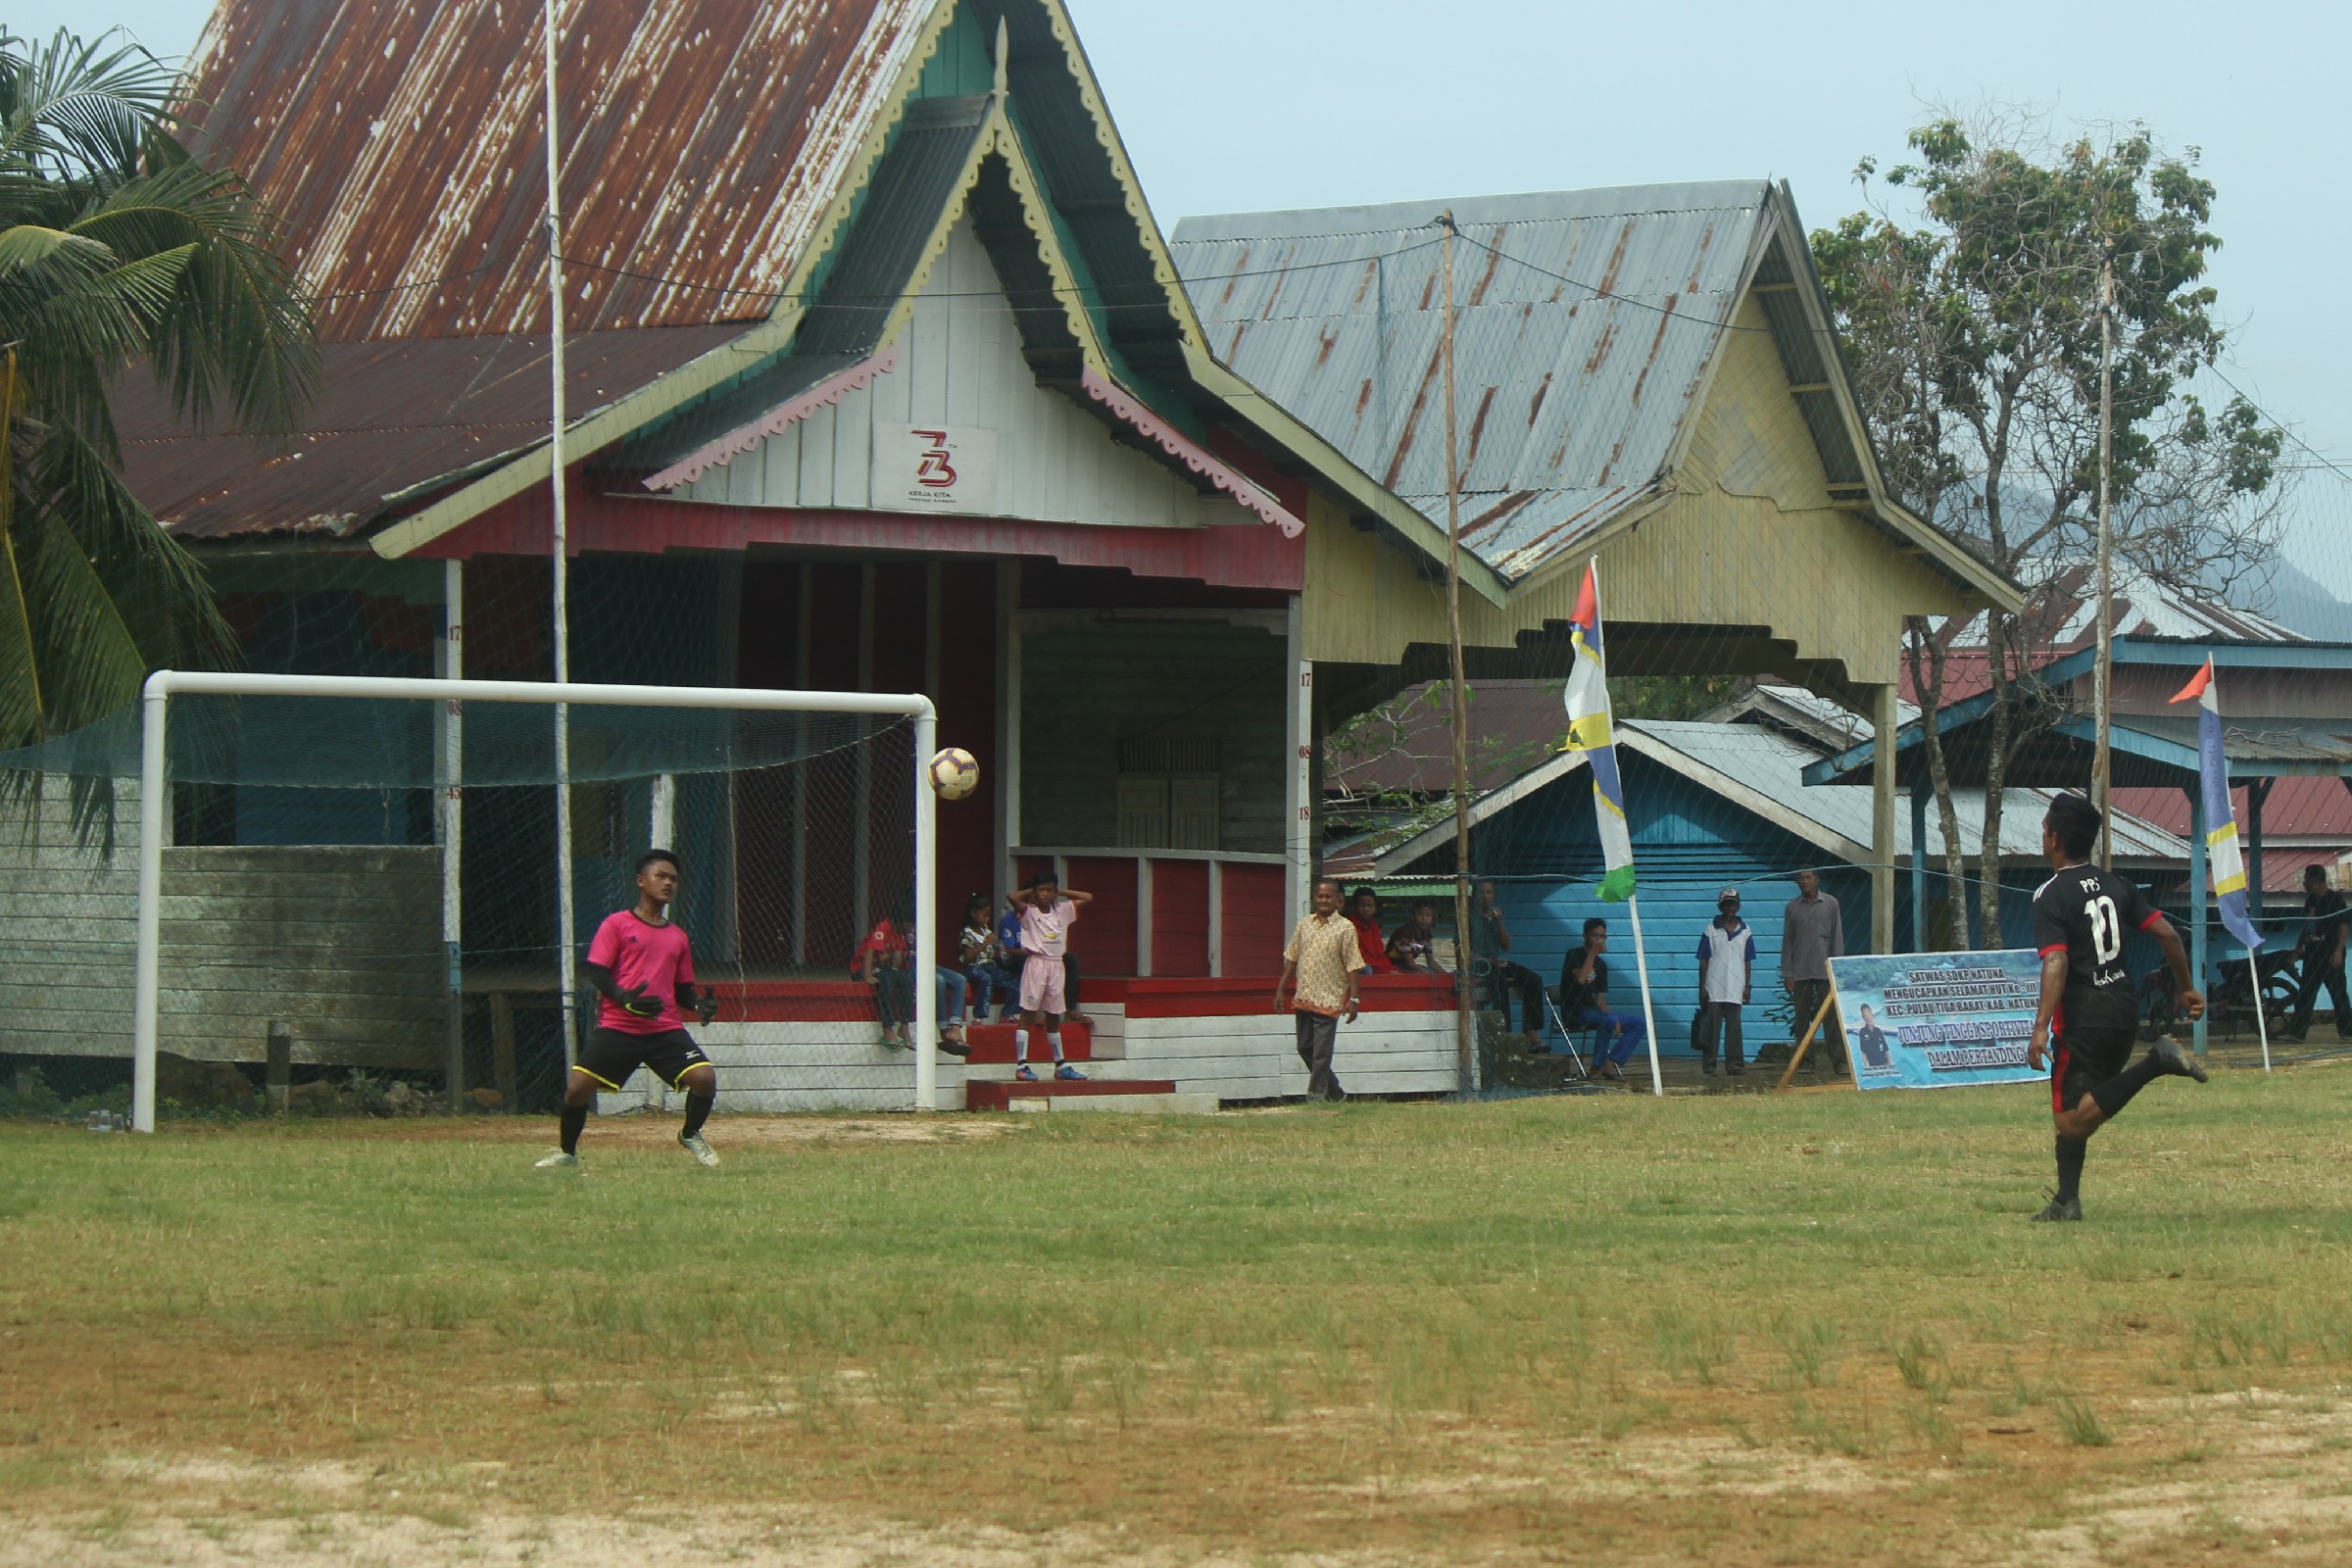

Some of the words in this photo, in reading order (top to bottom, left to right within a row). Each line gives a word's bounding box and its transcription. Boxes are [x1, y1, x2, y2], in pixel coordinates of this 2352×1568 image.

[449, 626, 461, 641] 17
[1299, 672, 1311, 688] 17
[1298, 745, 1311, 760] 08
[447, 786, 462, 801] 45
[1298, 807, 1310, 821] 18
[2083, 895, 2121, 965] 10
[1908, 969, 1946, 984] SATWAS
[1946, 968, 1969, 982] SDKP
[1970, 967, 2006, 981] NATUNA
[1883, 986, 1949, 1001] MENGUCAPKAN
[1950, 984, 1989, 998] SELAMAT
[1989, 983, 2008, 996] HUT
[1886, 1004, 1906, 1016] KEC.
[1907, 1002, 1936, 1015] PULAU
[1936, 1001, 1956, 1013] TIGA
[1898, 1024, 1943, 1043] JUNJUNG
[1943, 1021, 1979, 1040] TINGGI
[1928, 1049, 1961, 1067] DALAM
[1961, 1046, 2027, 1065] BERTANDING
